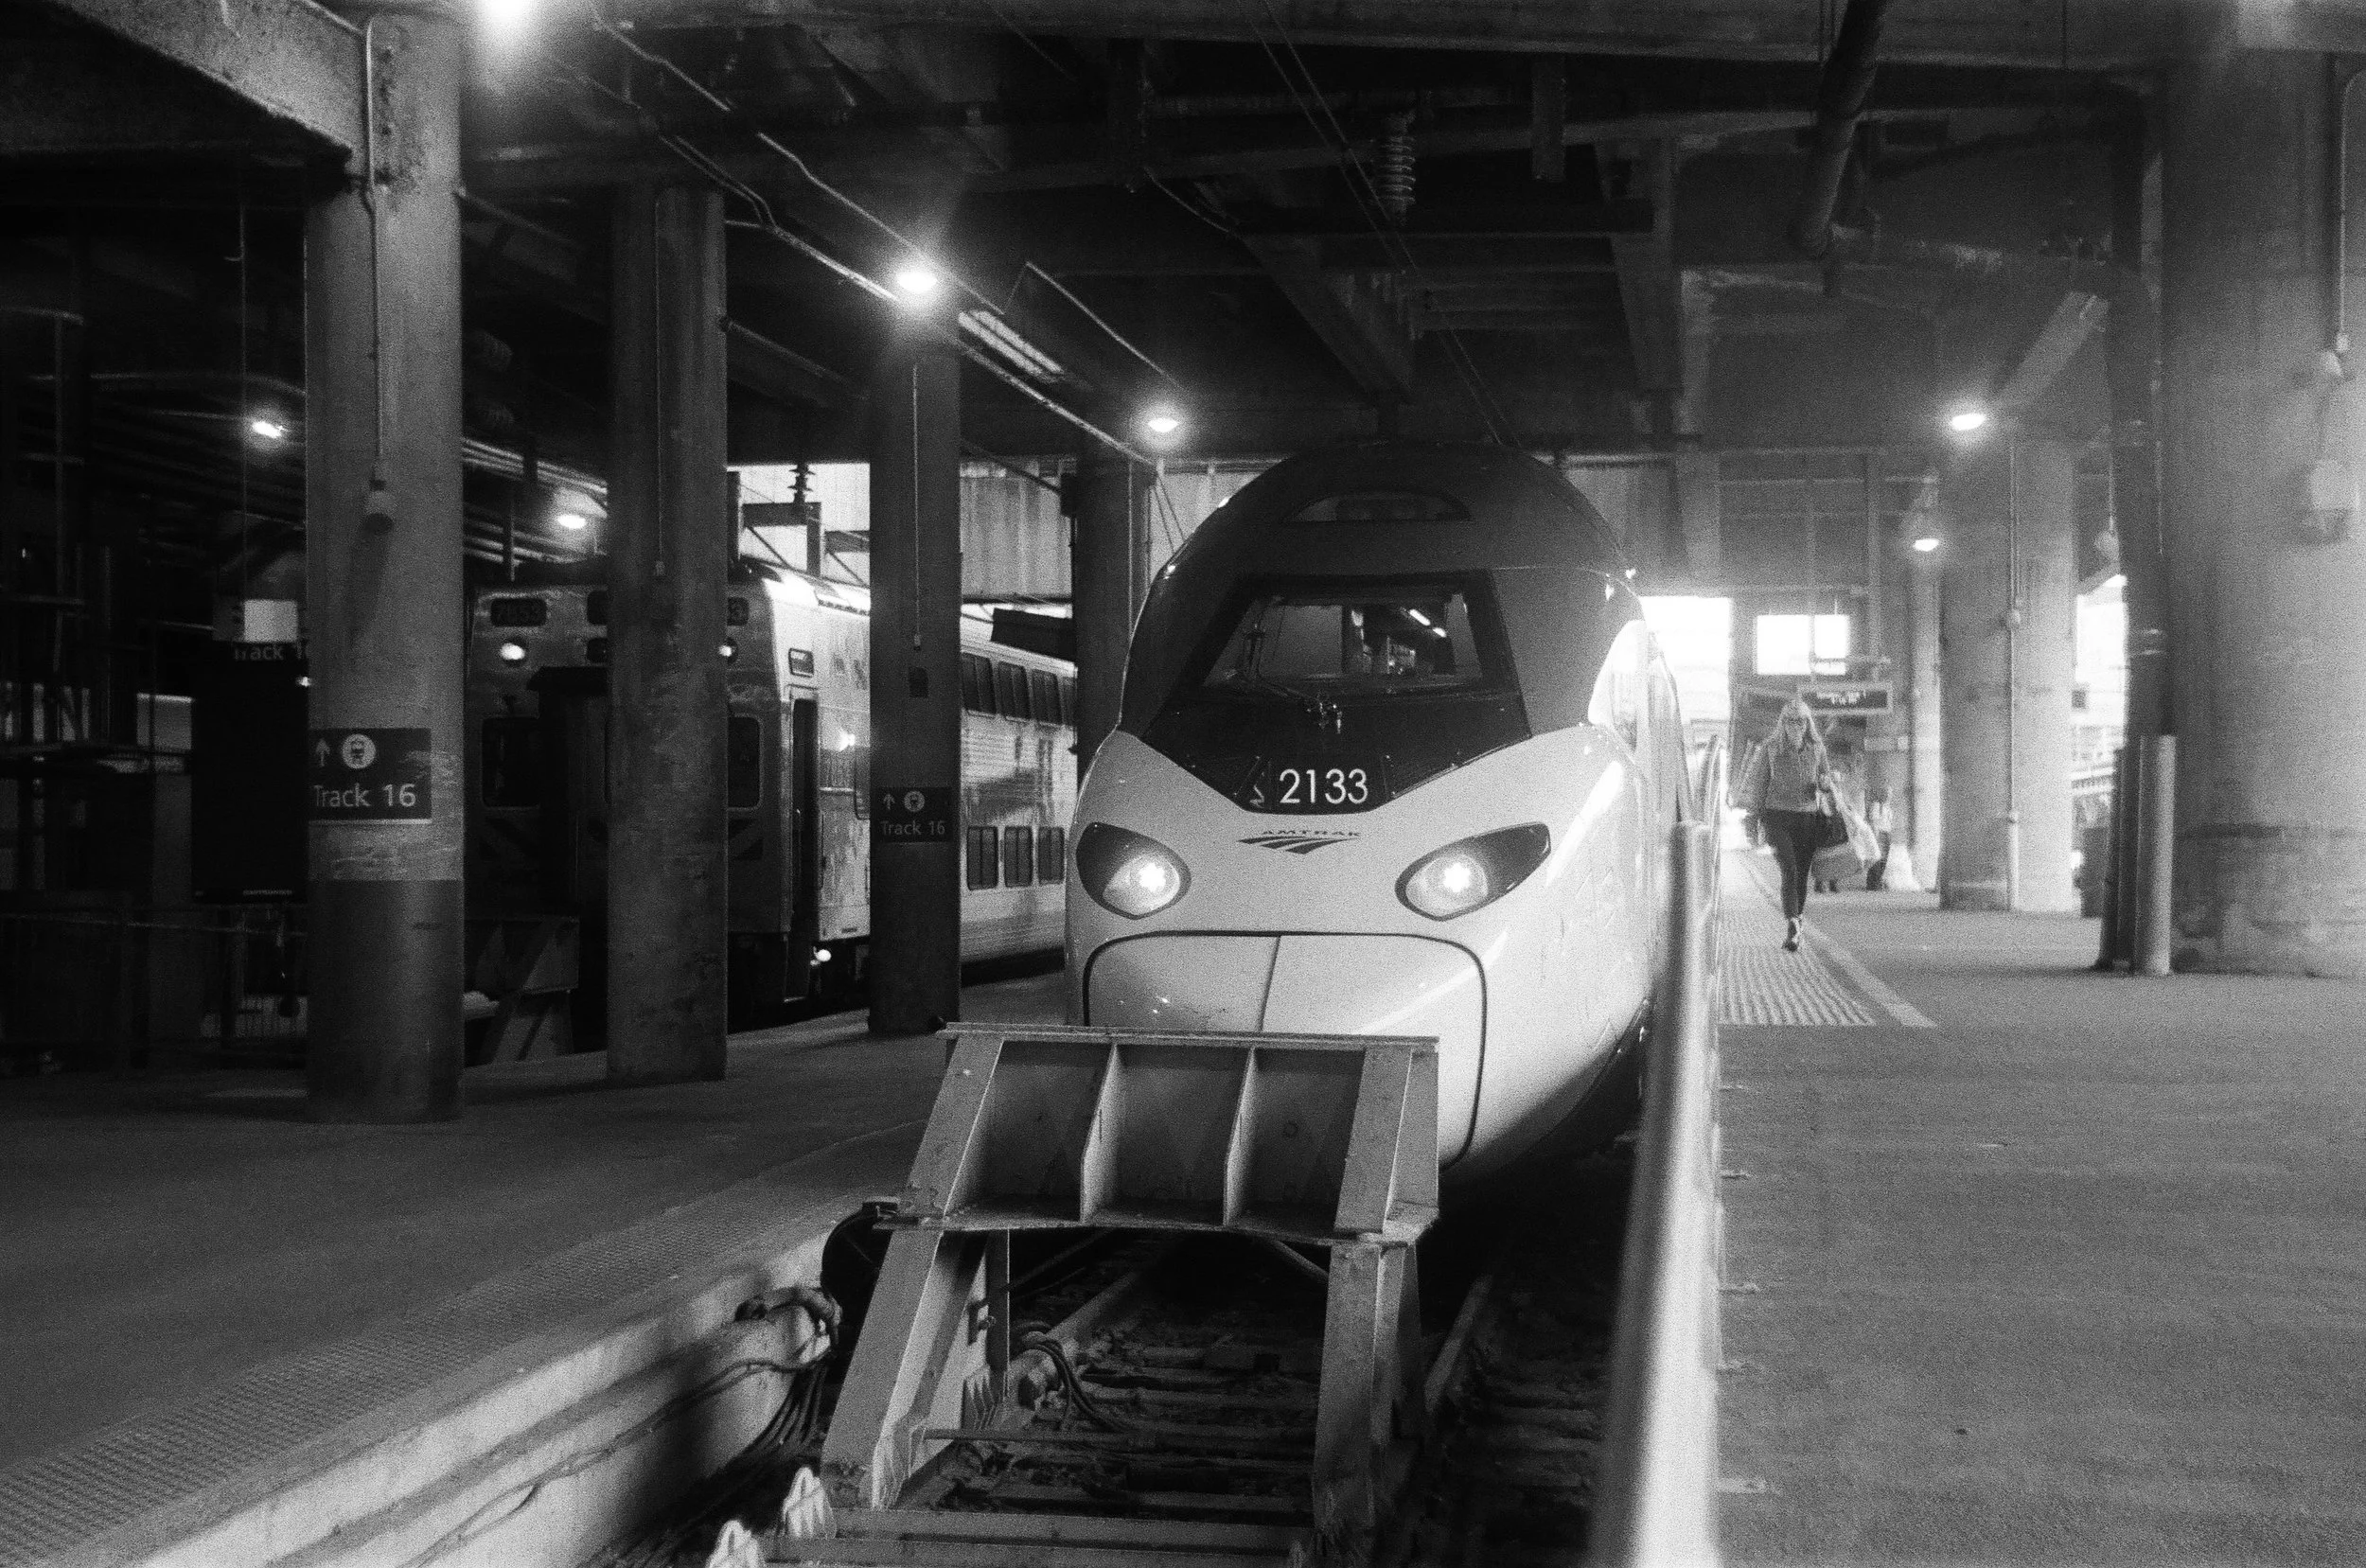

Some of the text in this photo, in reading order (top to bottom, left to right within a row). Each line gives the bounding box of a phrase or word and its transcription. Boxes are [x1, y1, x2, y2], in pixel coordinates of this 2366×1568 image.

[313, 783, 416, 807] Track 16
[1279, 767, 1368, 804] 2133
[879, 820, 946, 836] Track 16
[1262, 829, 1361, 837] AMTRAK
